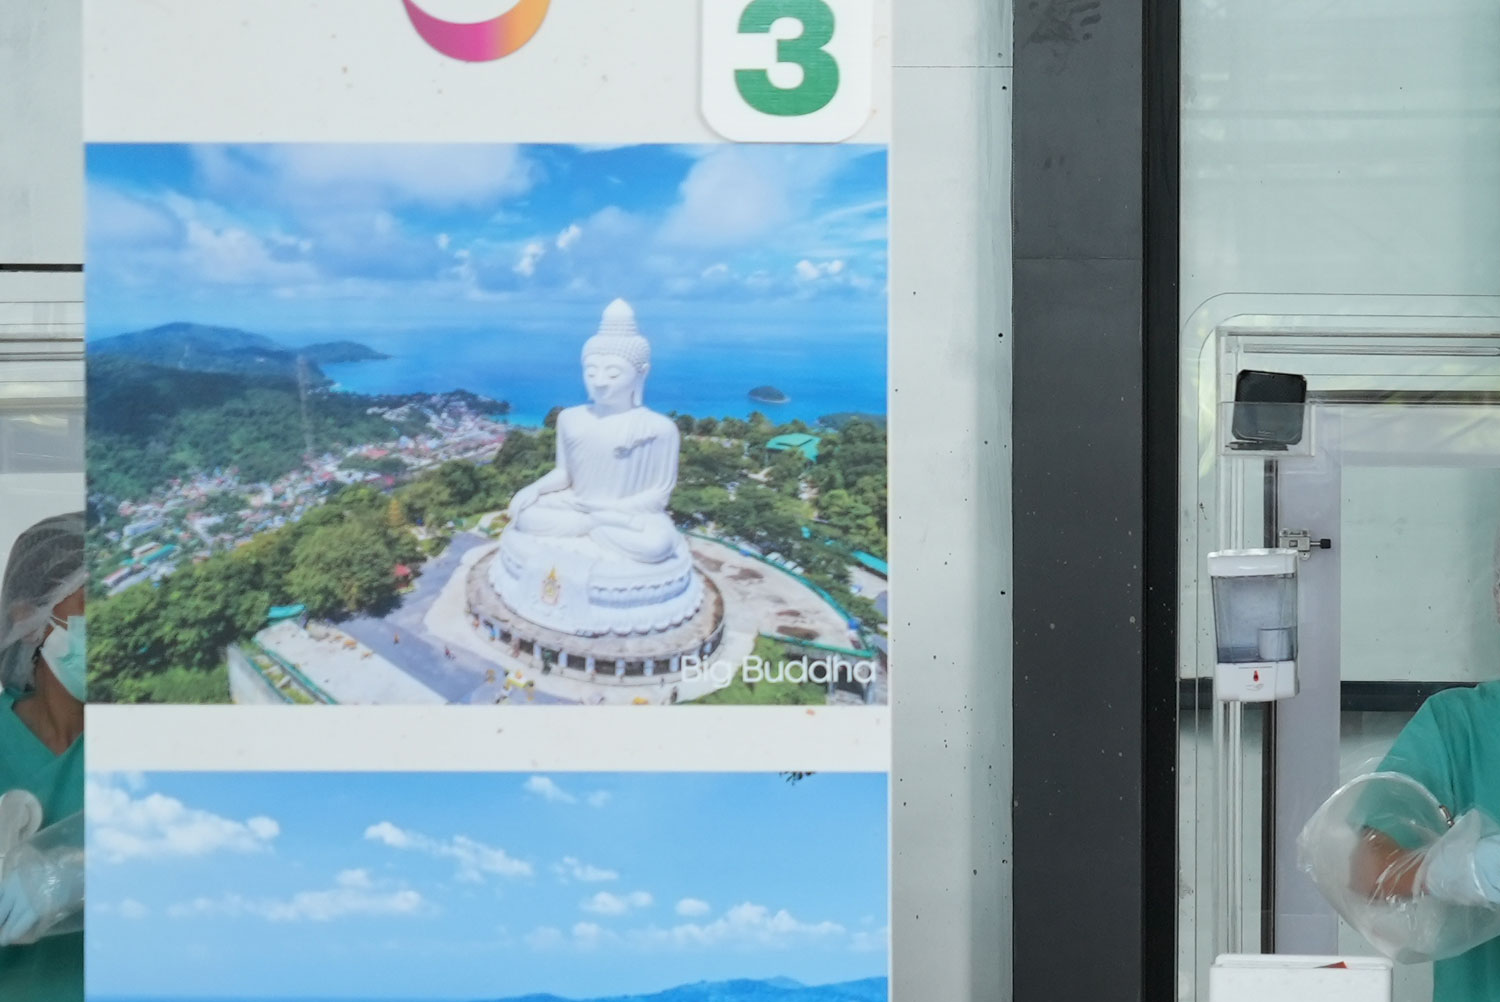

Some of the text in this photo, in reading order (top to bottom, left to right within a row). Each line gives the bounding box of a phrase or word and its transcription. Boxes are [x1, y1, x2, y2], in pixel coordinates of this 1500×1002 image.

[734, 0, 840, 116] 3
[681, 655, 877, 688] Big Buddha
